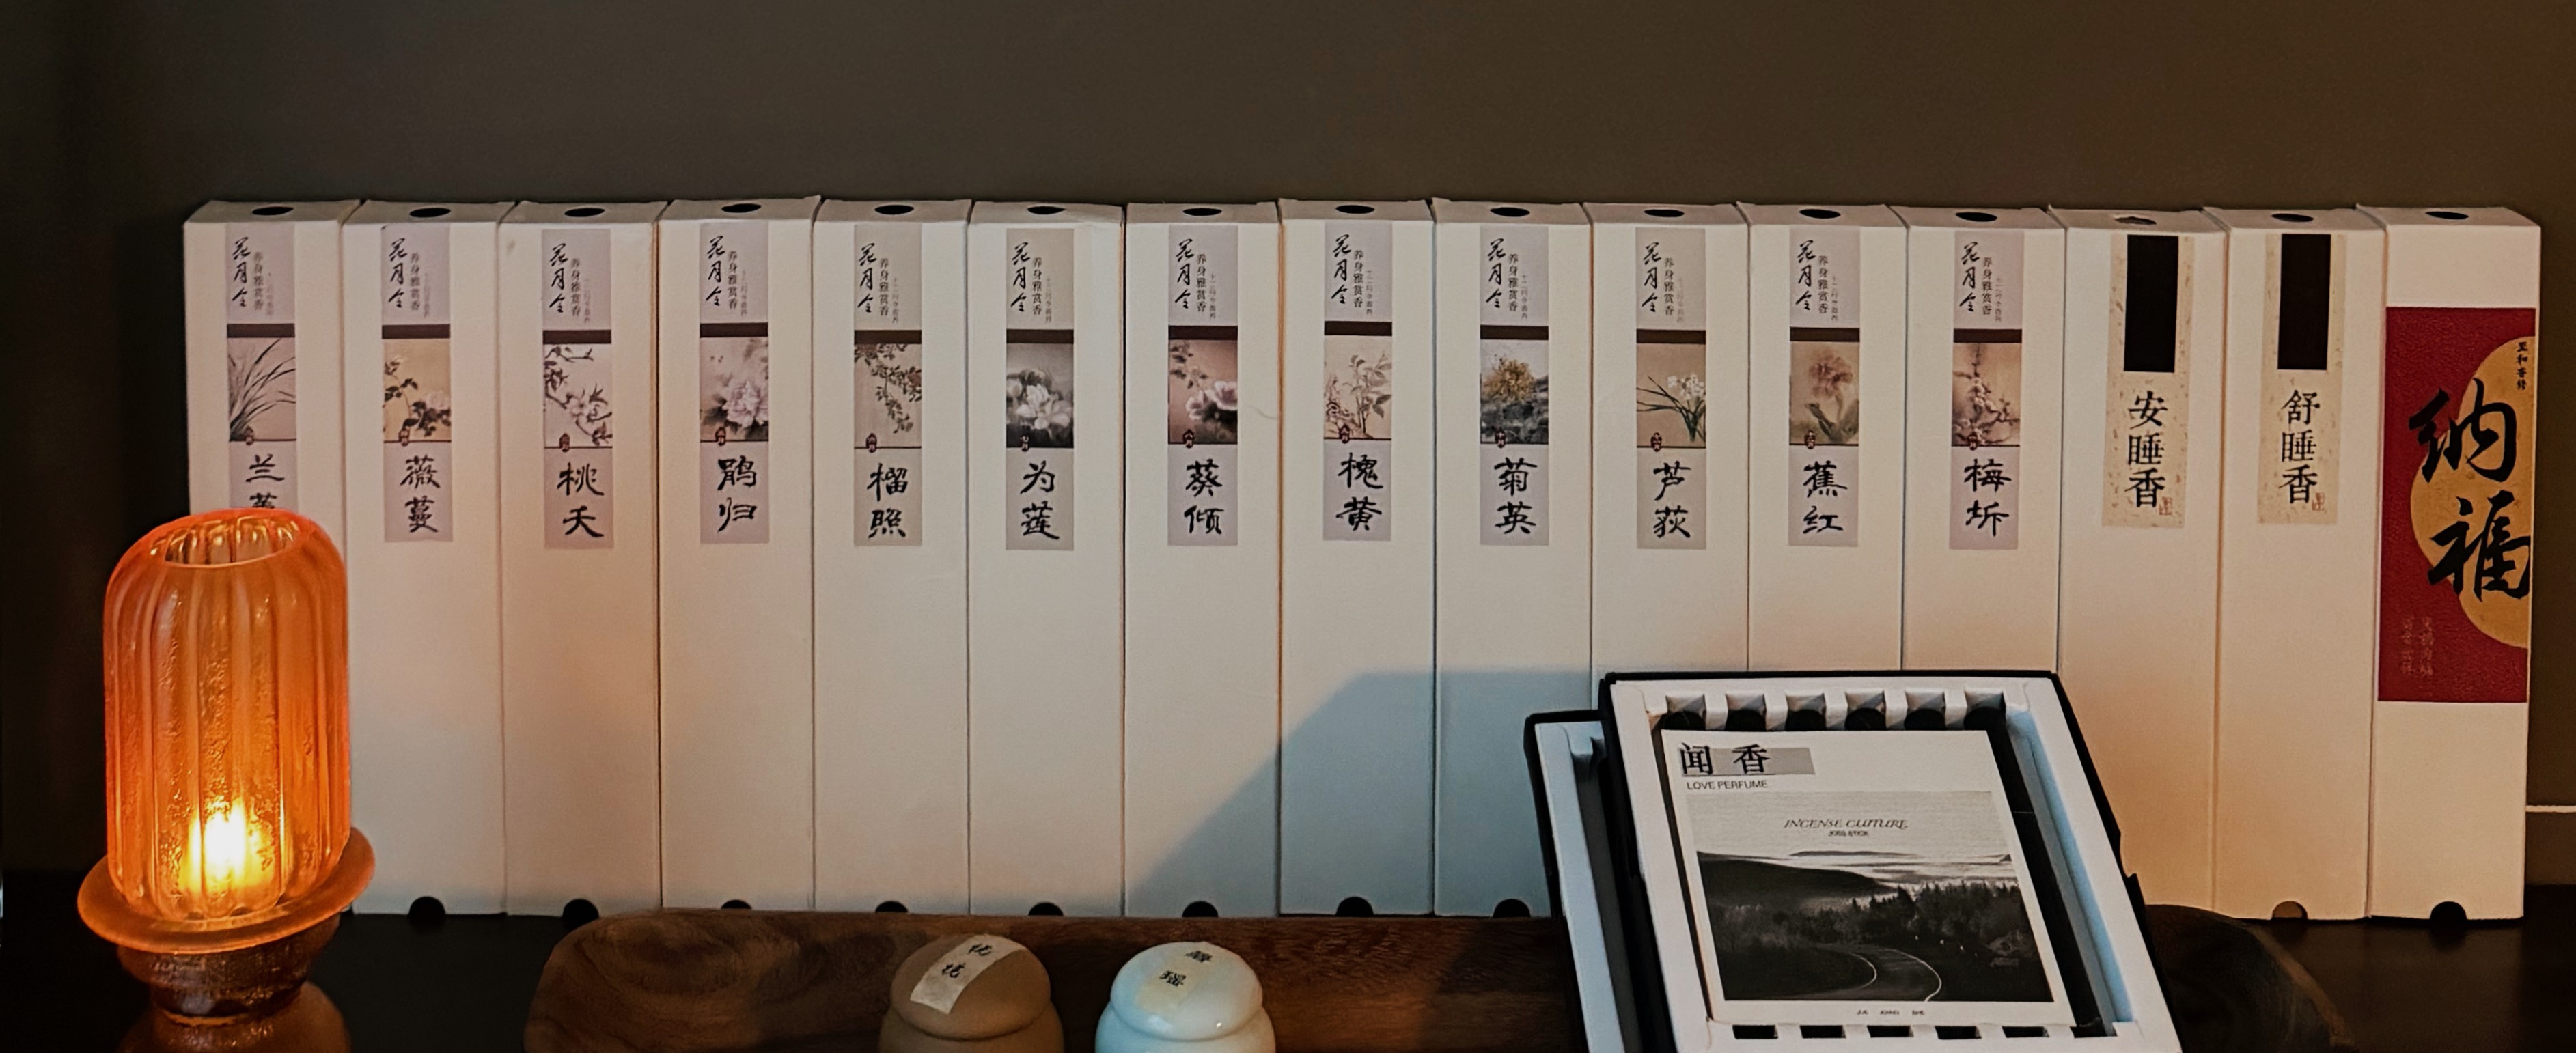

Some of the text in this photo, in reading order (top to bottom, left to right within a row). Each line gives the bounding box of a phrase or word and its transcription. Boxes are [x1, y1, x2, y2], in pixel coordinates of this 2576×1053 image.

[2124, 390, 2168, 508] 安睡香
[2278, 389, 2321, 504] 舒睡香
[717, 455, 758, 533] 鹃归
[866, 462, 909, 539] 榴照
[1020, 460, 1060, 540] 为莲
[1183, 458, 1225, 535] 葵倾
[1335, 451, 1384, 531] 槐黄
[1493, 456, 1538, 535] 菊英
[1652, 460, 1691, 539] 芦荻
[1802, 460, 1848, 535] 蕉红
[2408, 377, 2532, 602] 纳福
[1680, 742, 1770, 774] 闻香
[1687, 780, 1767, 790] LOVE PERFUME
